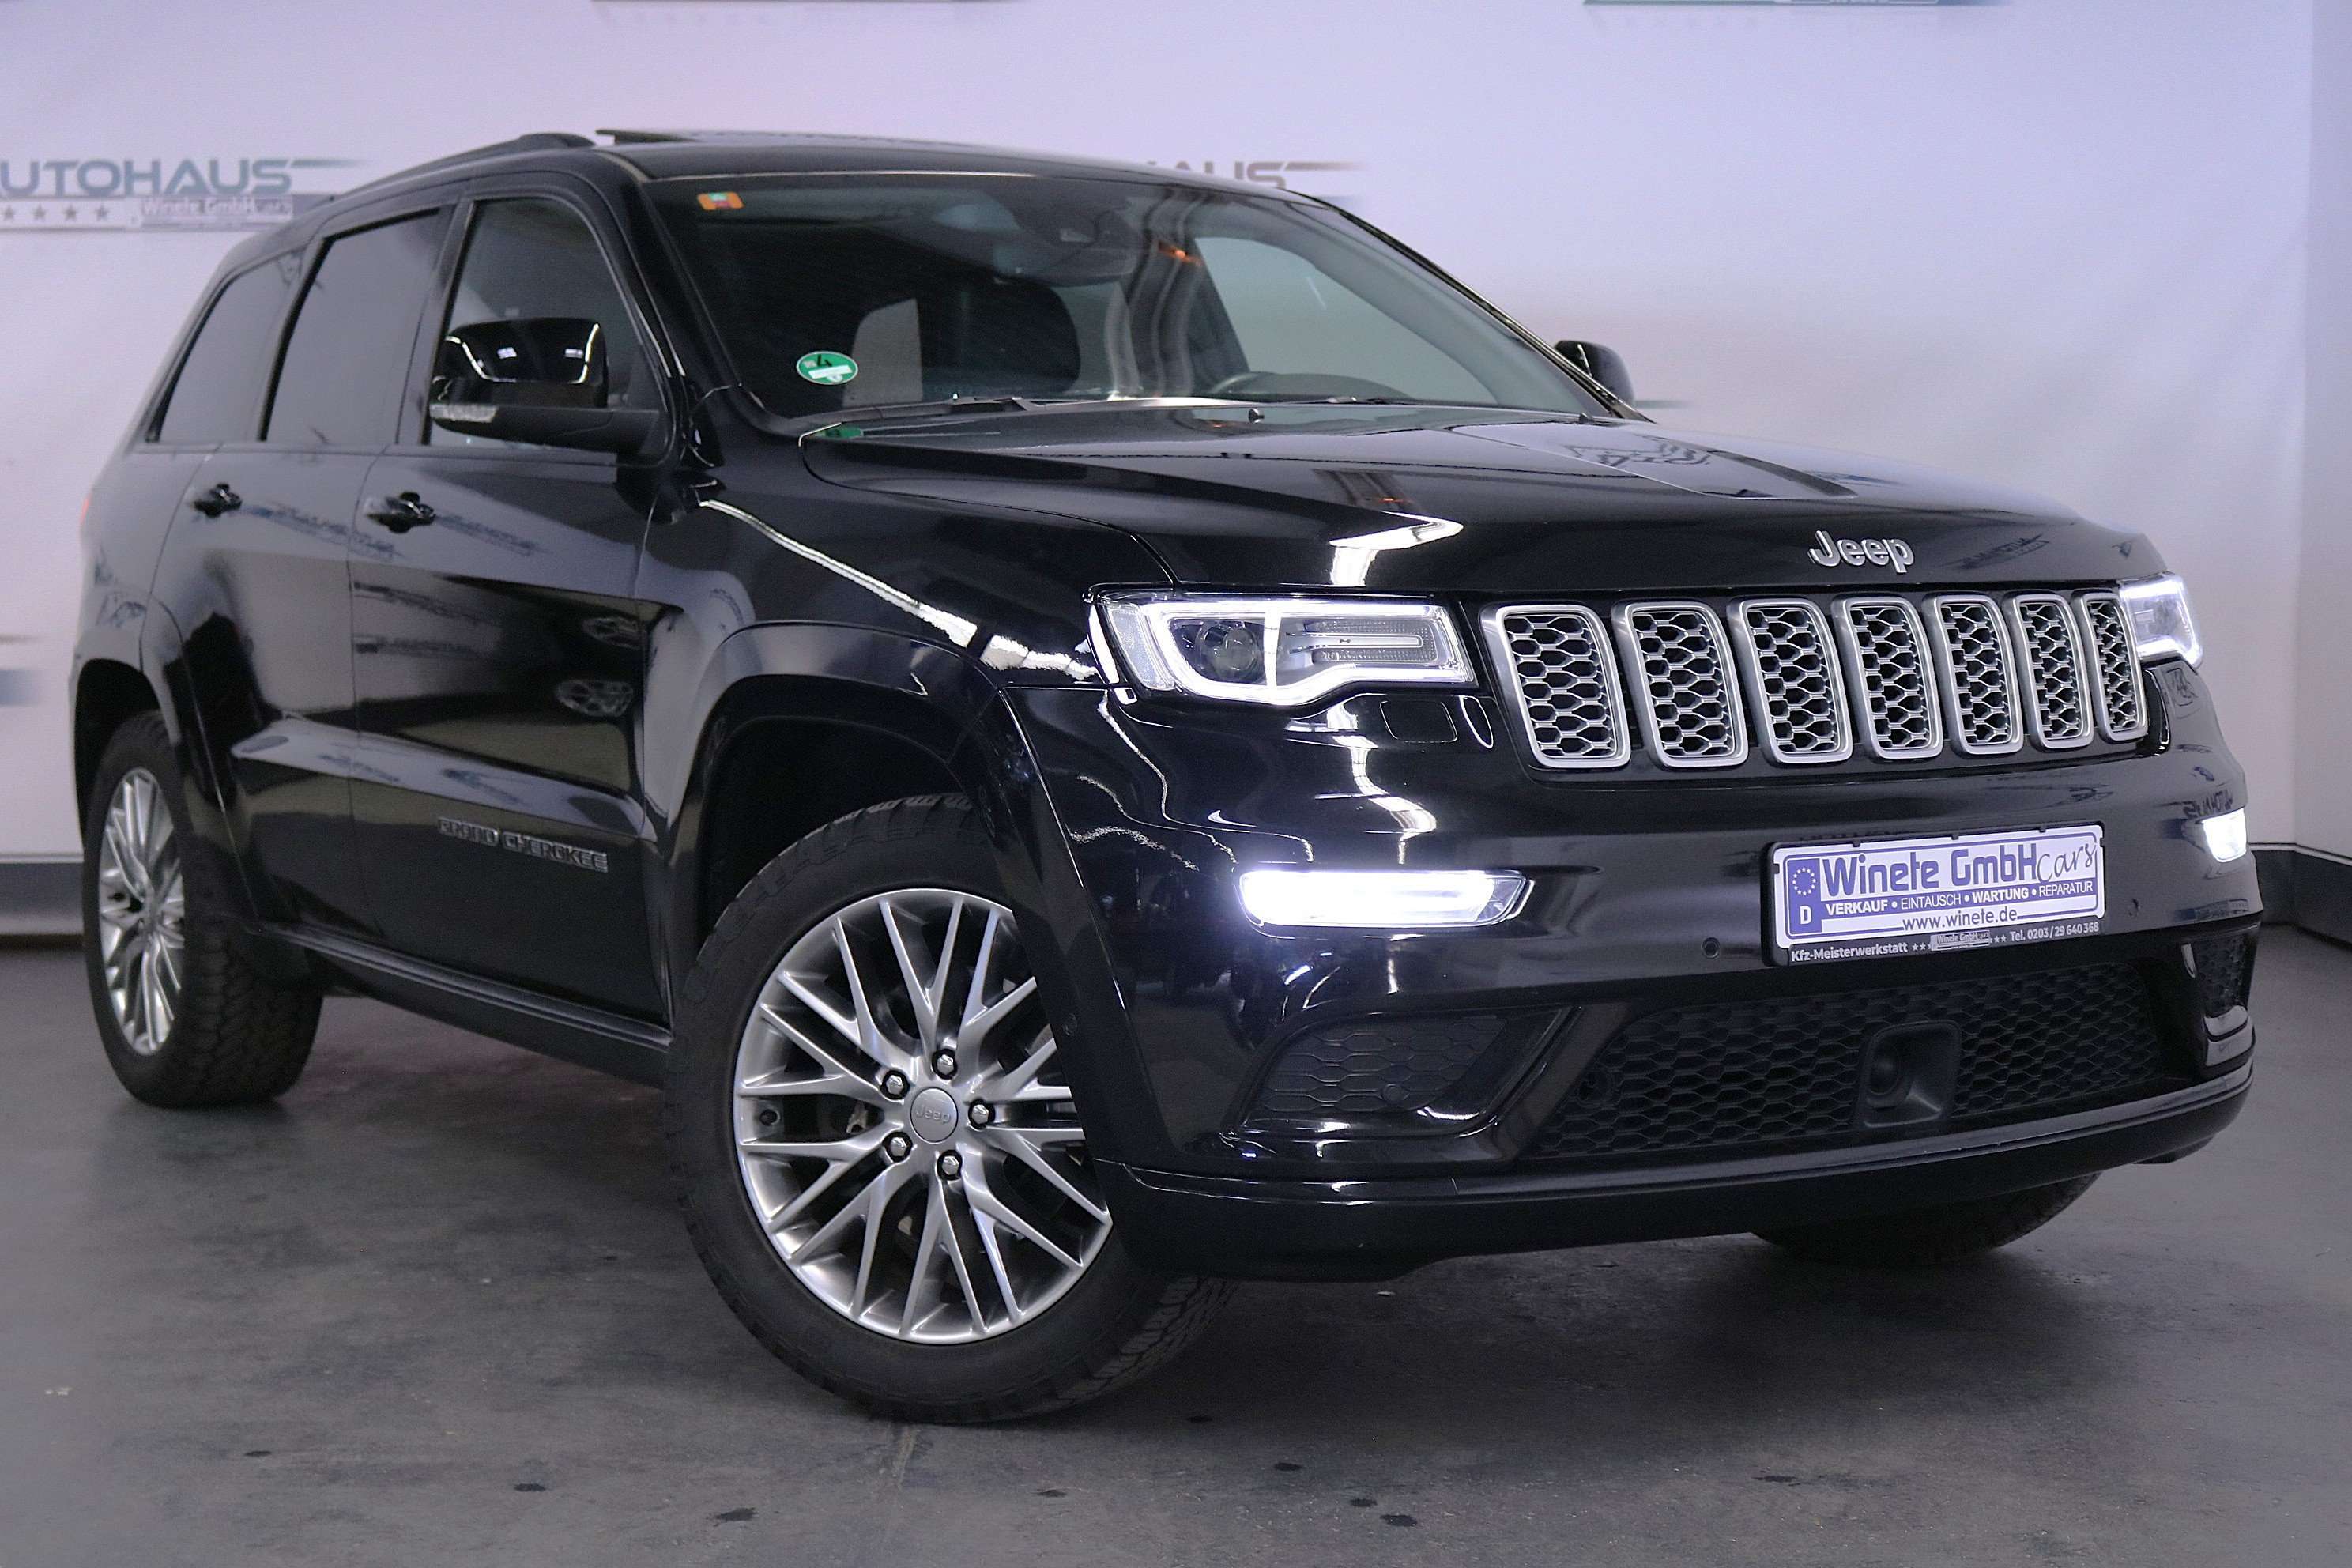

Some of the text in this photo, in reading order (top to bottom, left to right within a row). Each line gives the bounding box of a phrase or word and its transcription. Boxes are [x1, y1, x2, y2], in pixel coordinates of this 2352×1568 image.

[1807, 530, 1914, 573] Jeep
[502, 831, 609, 873] CHEROKEE
[1822, 852, 1939, 897] Winete
[1951, 843, 2037, 887] GmbH
[1800, 905, 1813, 925] D
[1826, 880, 2094, 916] VERKAUF EINTAUSCH WARTUNG REPARATUR
[1903, 906, 2018, 931] www.winete.de
[1791, 941, 1908, 963] Kfz-Meisterwerkstatt
[2010, 930, 2025, 942] Tel.
[915, 1104, 952, 1125] Jeep
